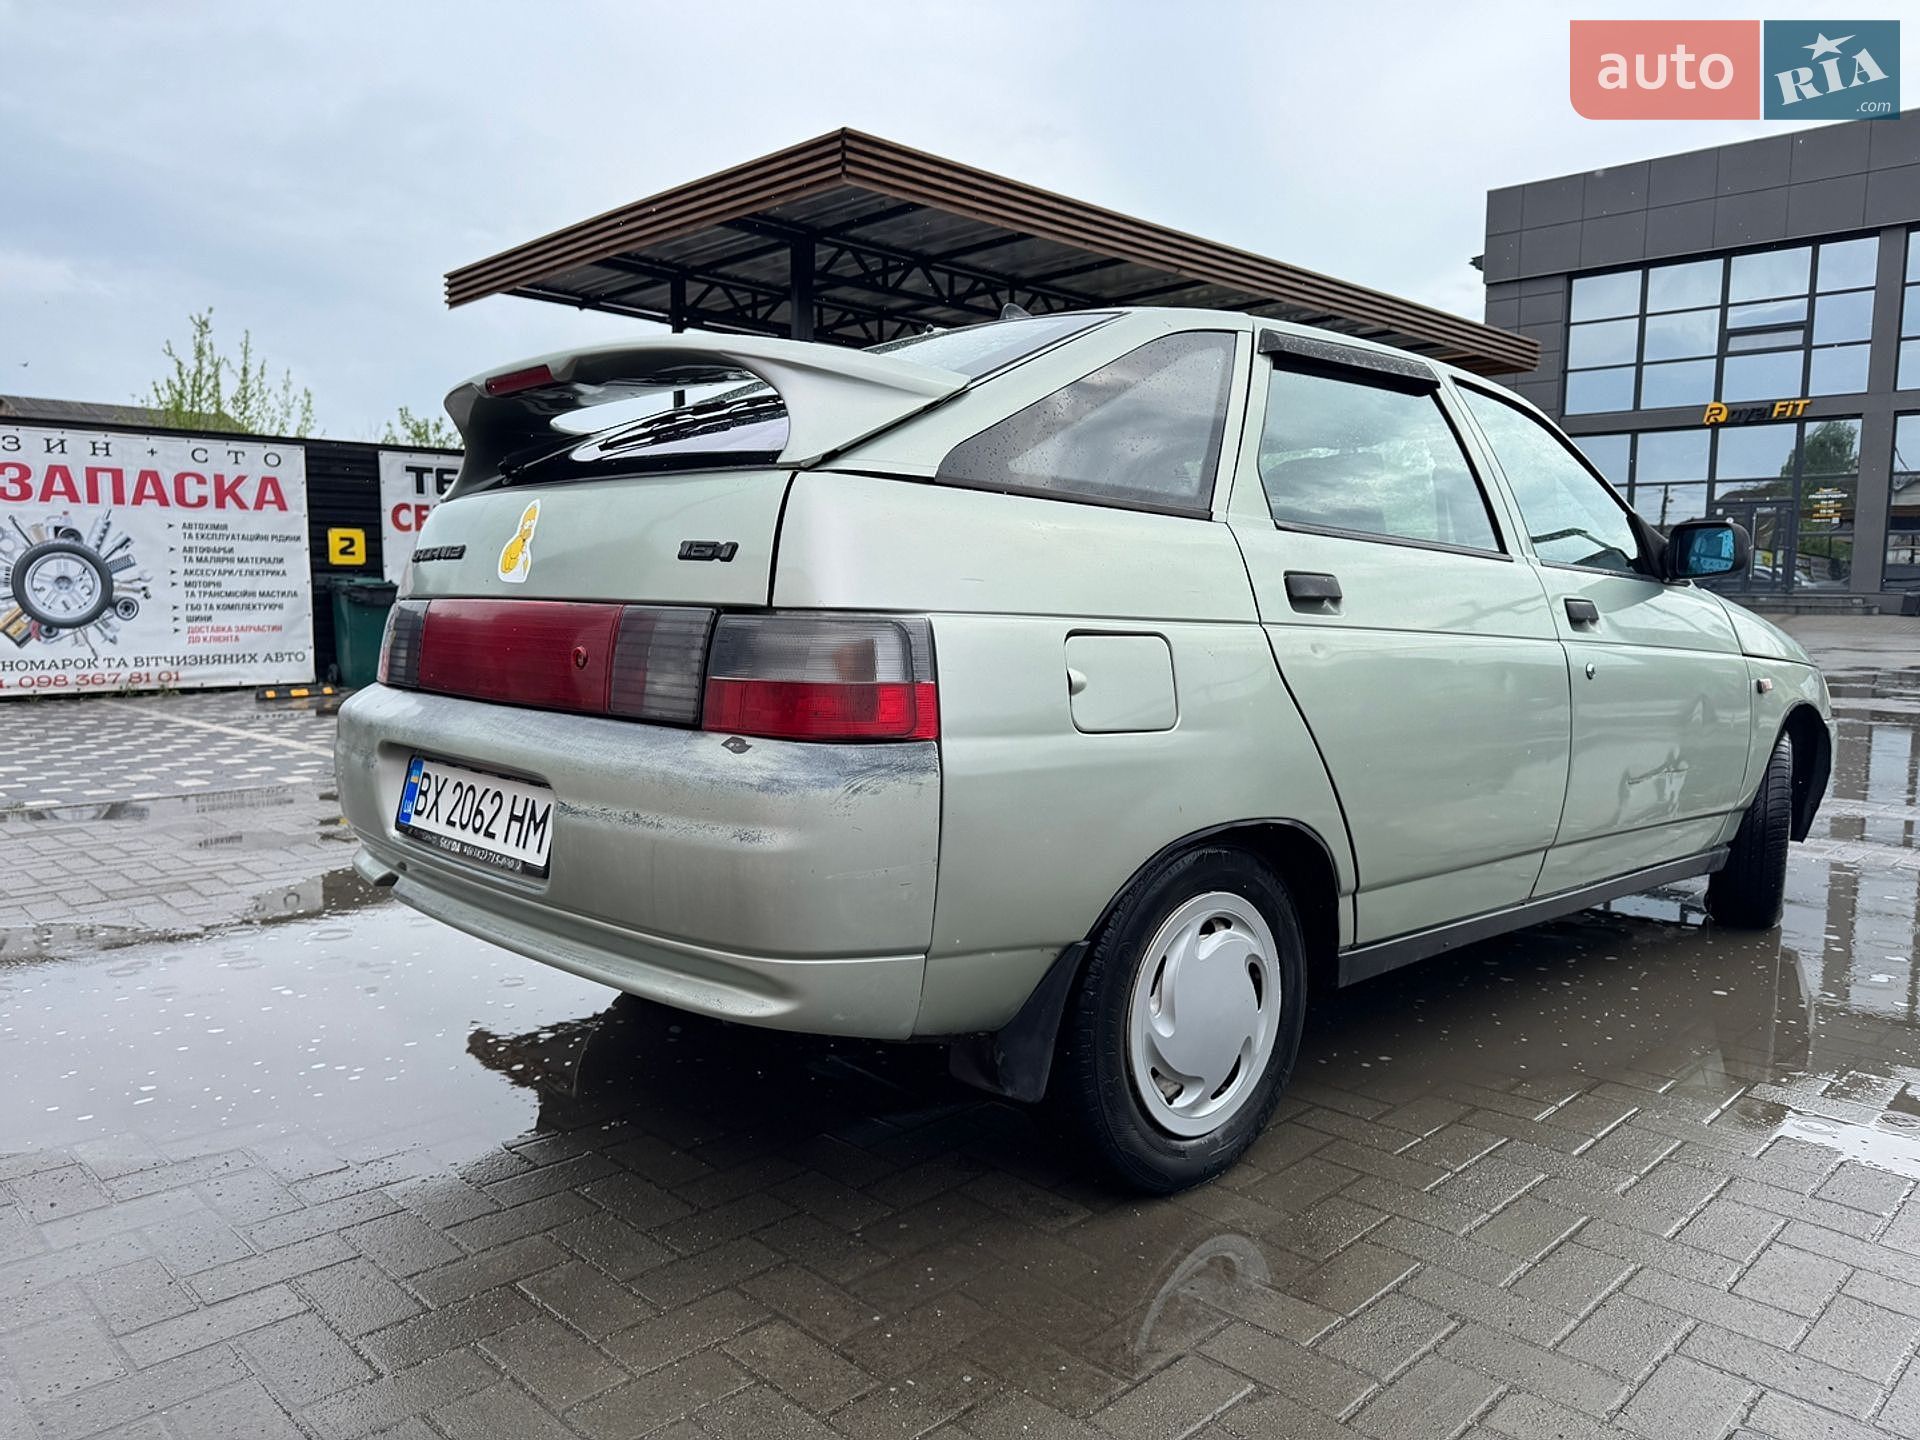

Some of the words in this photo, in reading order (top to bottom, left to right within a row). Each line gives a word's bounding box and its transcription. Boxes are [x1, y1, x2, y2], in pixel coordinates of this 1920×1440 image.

[190, 447, 282, 468] СТО
[0, 462, 288, 511] ЗАПАСКА
[391, 503, 432, 532] СЕ
[183, 532, 194, 540] ТА
[339, 537, 356, 556] 2
[183, 556, 194, 564] ТА
[185, 590, 196, 598] ТА
[258, 590, 298, 598] МАСТИЛА
[204, 603, 214, 611] ТА
[185, 615, 213, 623] ШИНИ
[187, 625, 232, 634] ДОСТАВКА
[103, 657, 129, 669] ТА
[134, 651, 258, 668] ВІТЧИЗНЯНИХ
[262, 651, 306, 664] АВТО
[18, 674, 69, 688] 098
[75, 672, 121, 686] 367
[128, 671, 151, 684] 81
[414, 772, 448, 823] BX
[446, 781, 503, 840] 2062
[504, 795, 551, 854] HM
